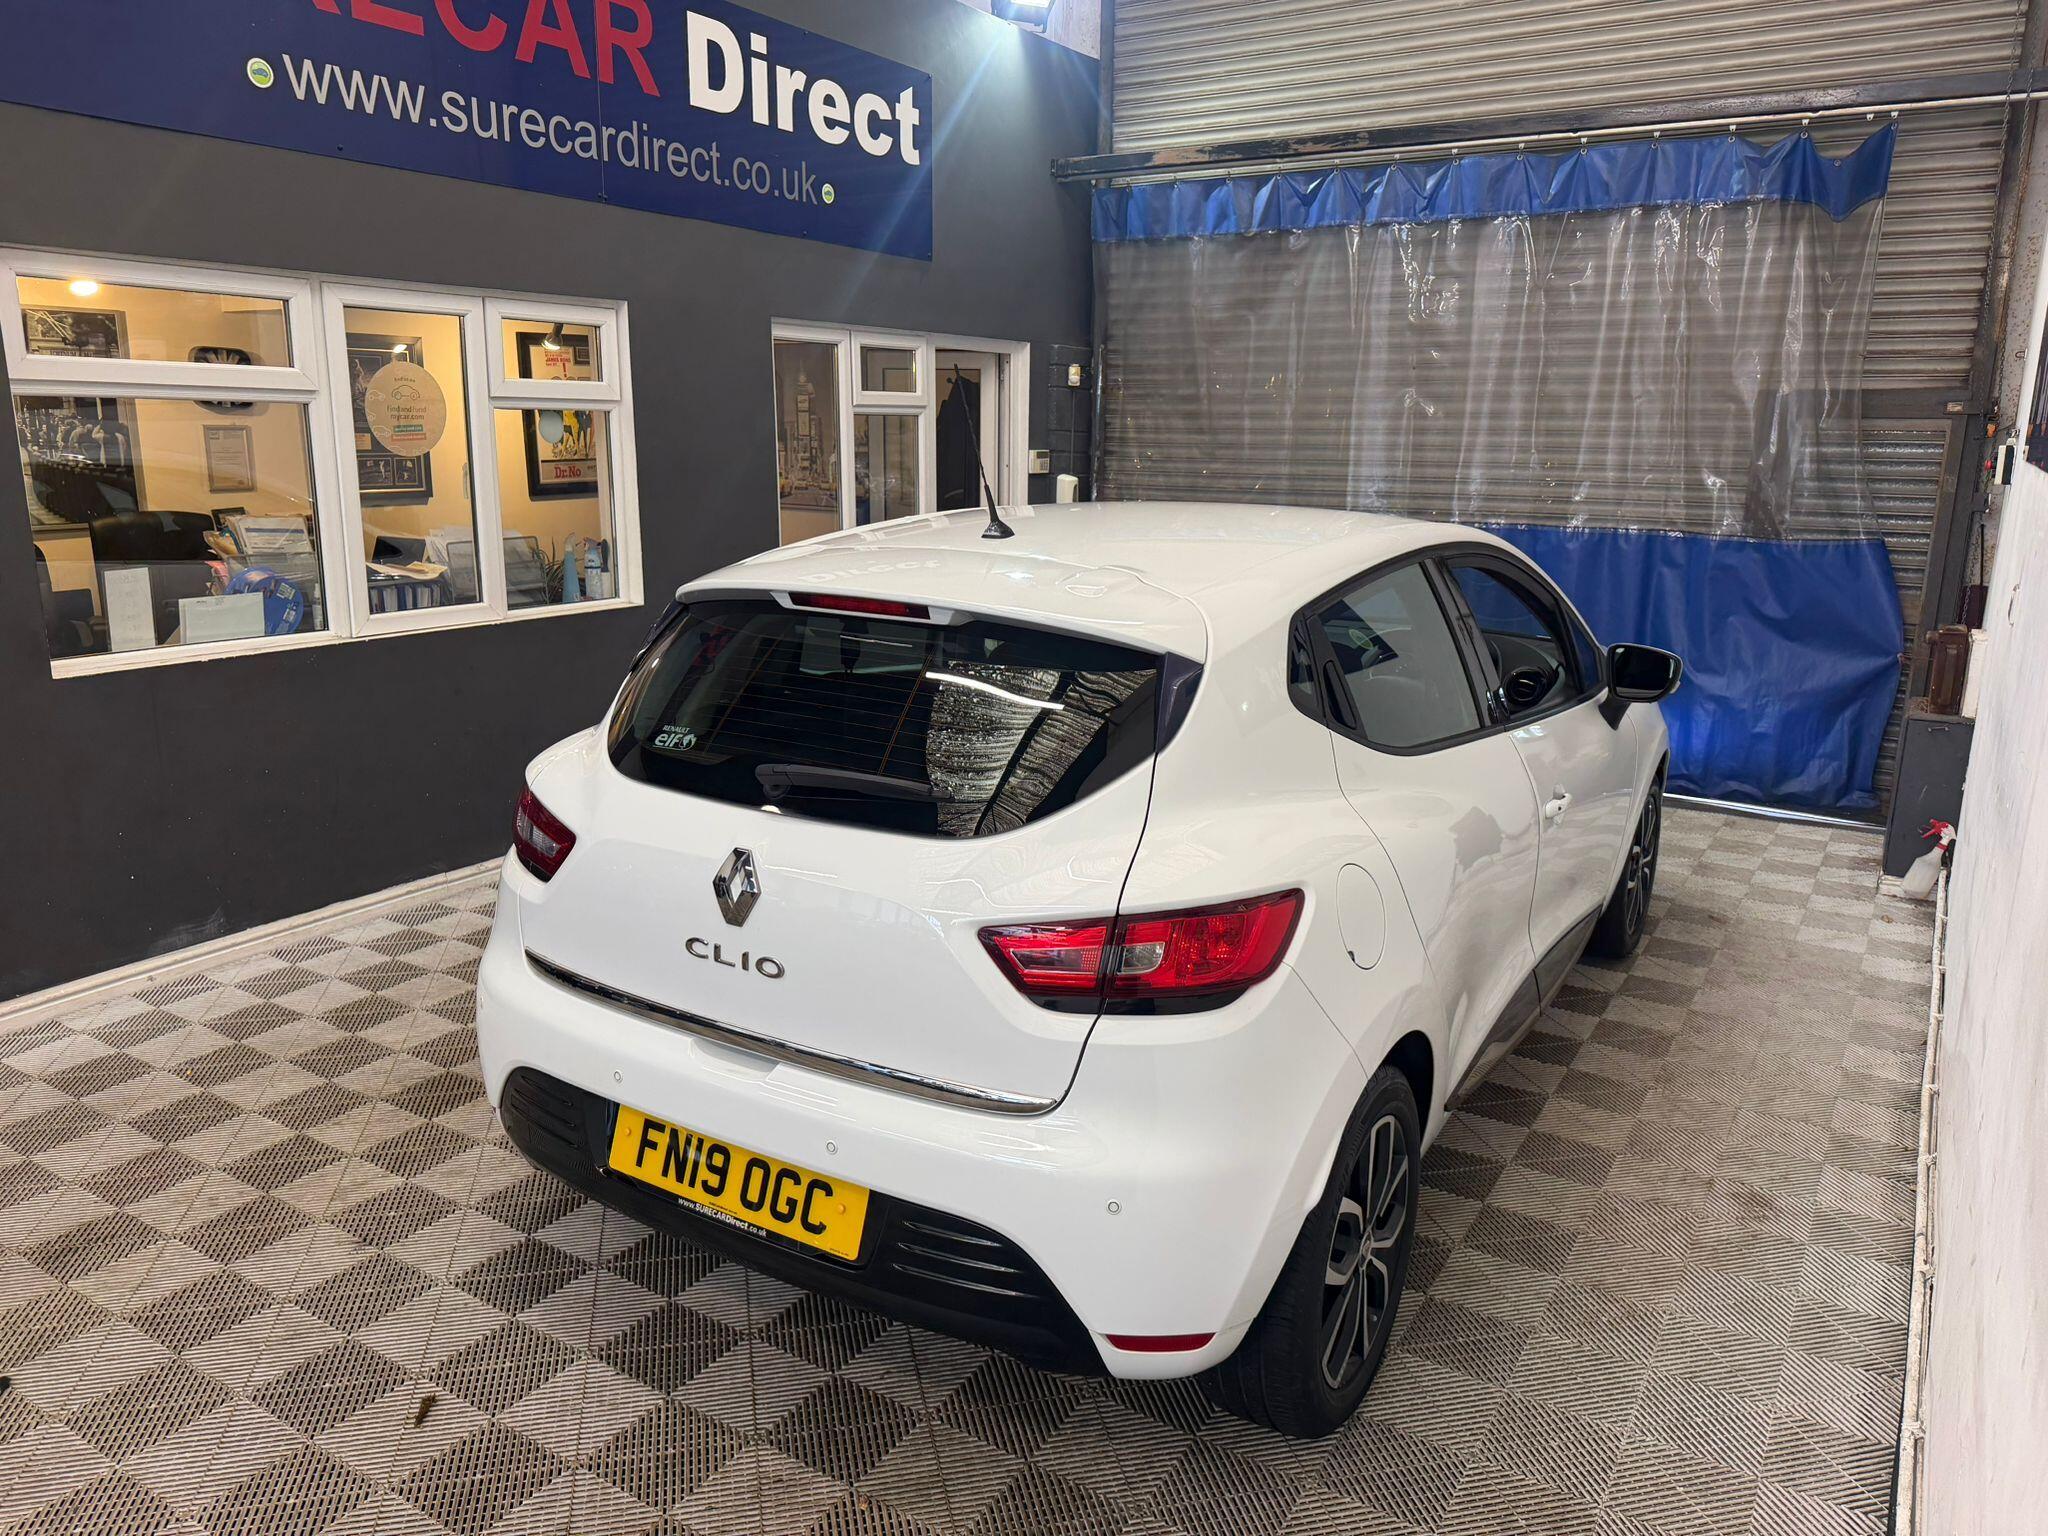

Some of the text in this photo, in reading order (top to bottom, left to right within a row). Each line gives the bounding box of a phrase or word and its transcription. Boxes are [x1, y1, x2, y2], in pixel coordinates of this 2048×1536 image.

[282, 54, 819, 206] www.surecardirect.co.uk
[686, 10, 921, 166] Direct
[663, 724, 690, 733] RENAULT
[685, 937, 785, 979] CLIO
[635, 1117, 834, 1235] FN19 OGC
